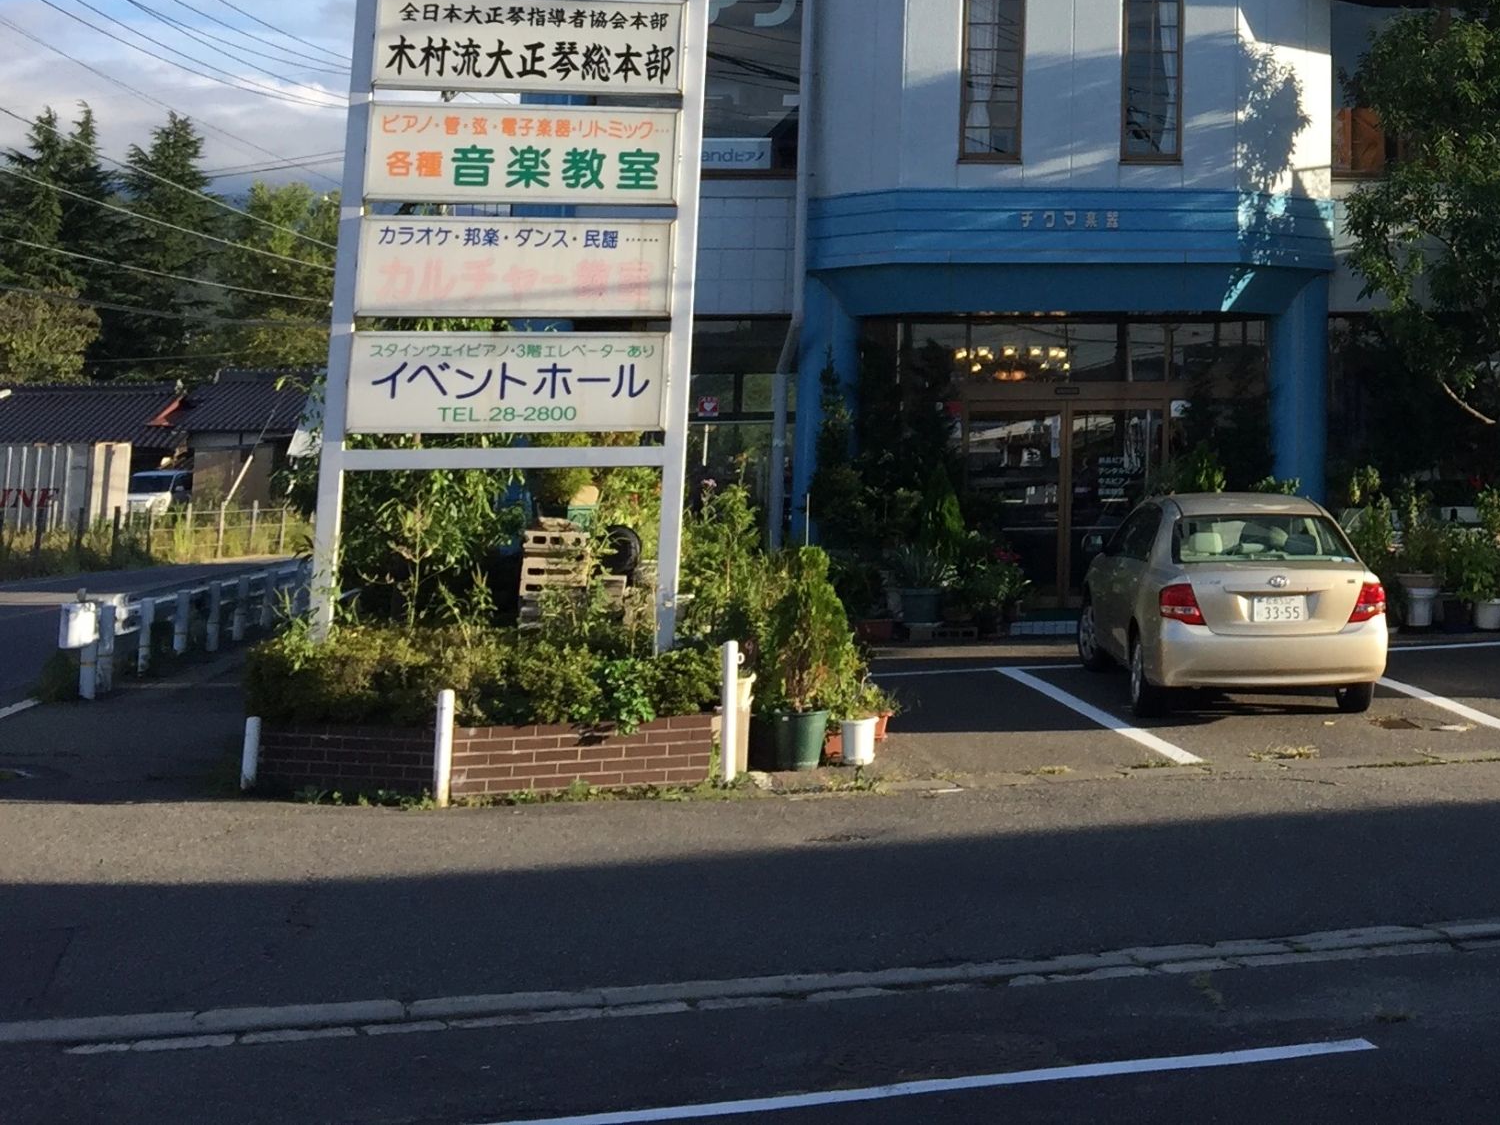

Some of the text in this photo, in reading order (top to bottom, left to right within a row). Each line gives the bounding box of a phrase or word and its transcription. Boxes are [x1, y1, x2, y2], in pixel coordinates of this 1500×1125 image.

[399, 2, 669, 31] 全日本大正琴指導者協会本部
[385, 35, 675, 85] 木村流大正琴総本部
[1021, 211, 1119, 228] チクマ楽器
[371, 361, 650, 400] イベントホール
